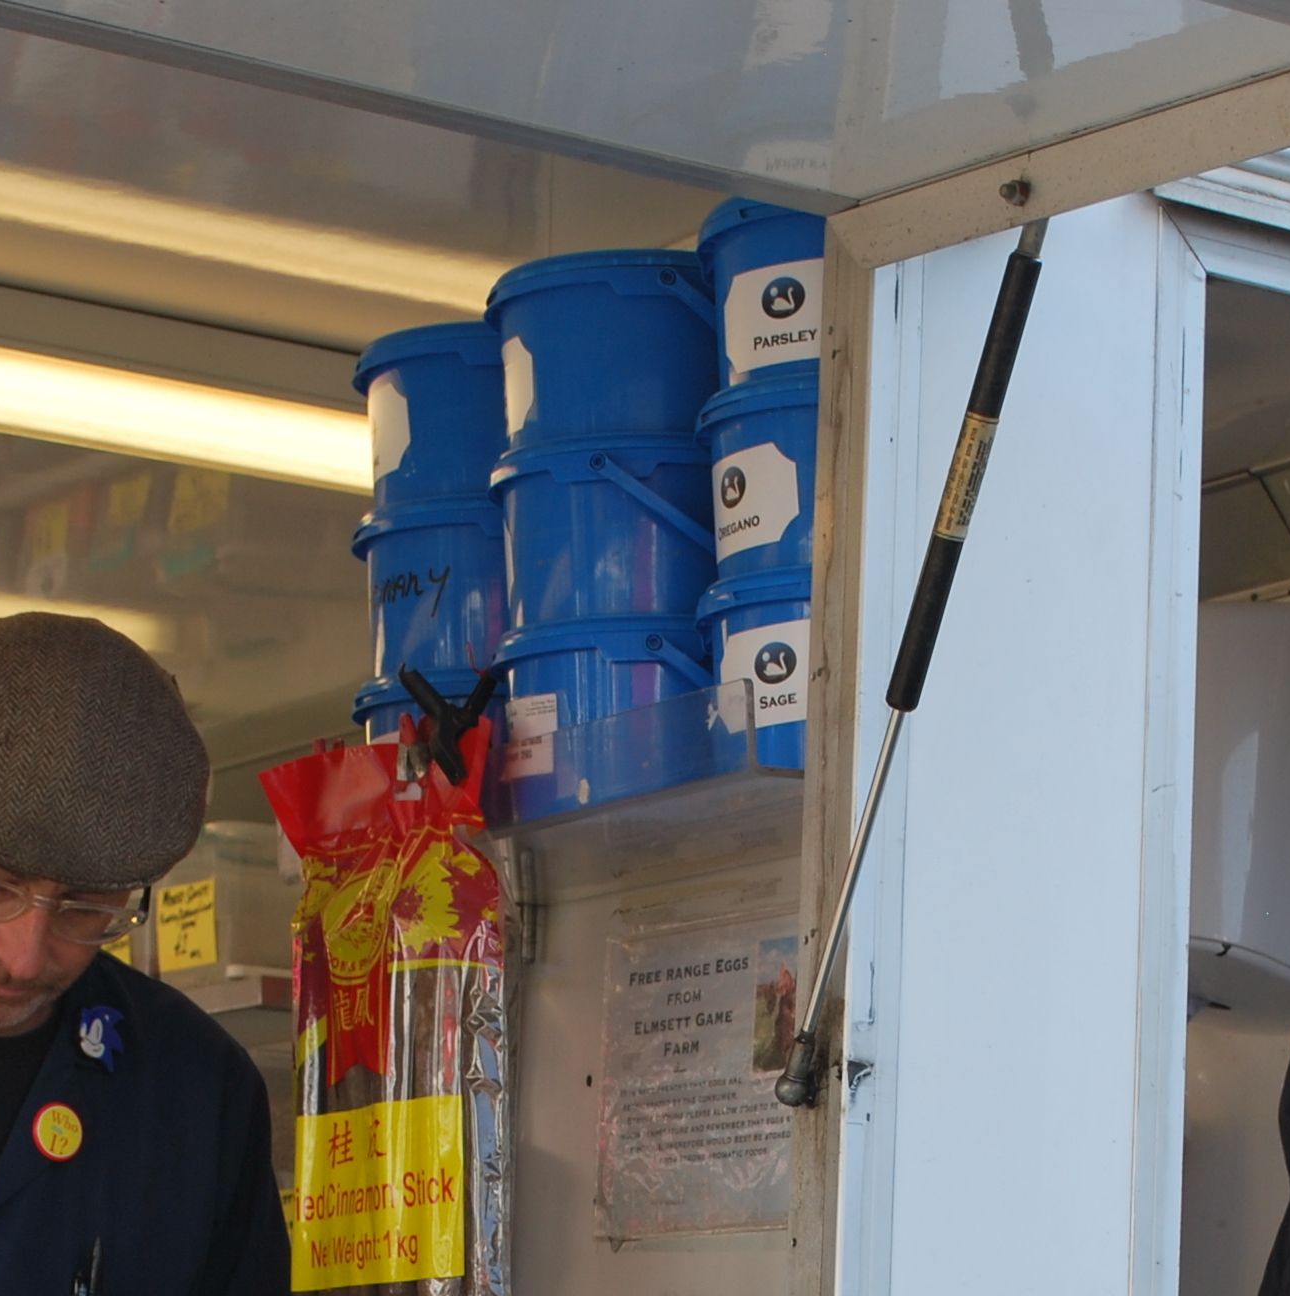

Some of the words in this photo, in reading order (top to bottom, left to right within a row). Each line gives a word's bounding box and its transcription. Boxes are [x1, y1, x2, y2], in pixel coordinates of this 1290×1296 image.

[753, 329, 817, 350] PARSLEY
[759, 693, 797, 710] SAGE
[629, 970, 662, 987] FREE
[666, 962, 711, 982] RANGE
[715, 956, 749, 974] EGGS
[667, 989, 702, 1006] FROM
[634, 1015, 691, 1036] ELMSETT
[695, 1010, 733, 1027] GAME
[663, 1041, 700, 1057] FARM
[403, 1168, 455, 1208] Stick
